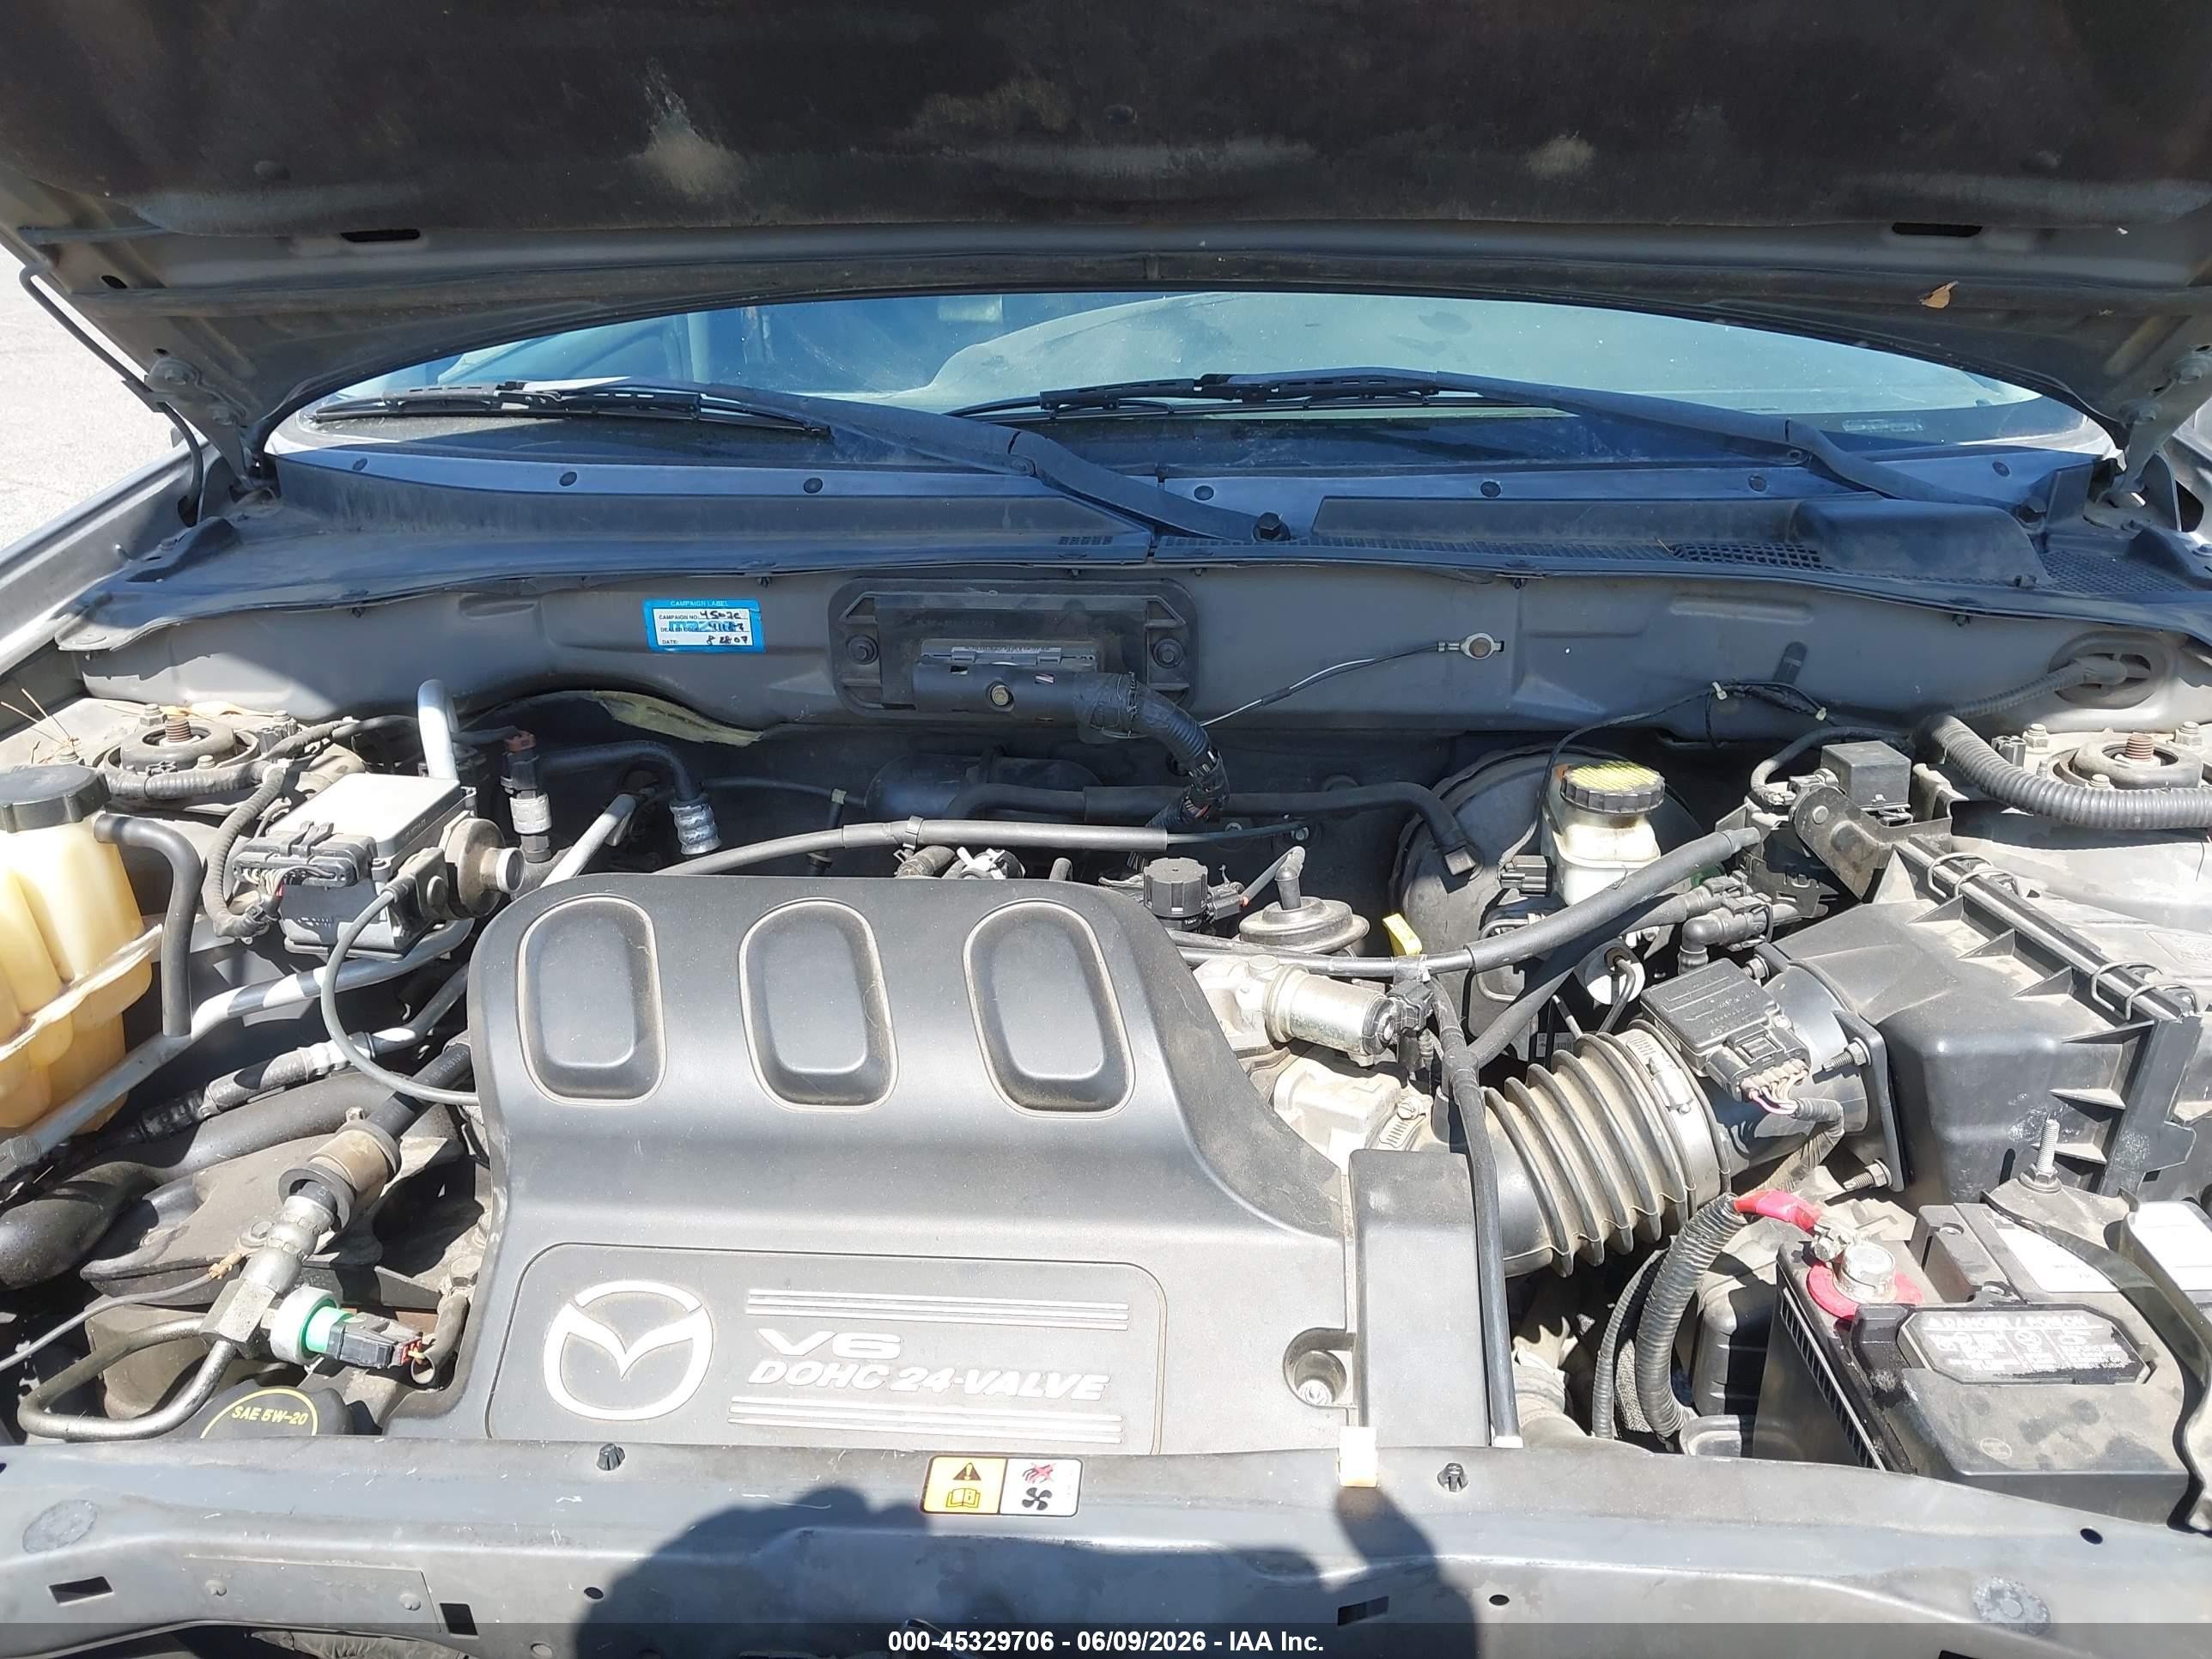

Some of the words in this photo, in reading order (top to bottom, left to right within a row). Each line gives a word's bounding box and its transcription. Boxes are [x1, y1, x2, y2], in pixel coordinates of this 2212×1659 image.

[757, 1328, 902, 1359] V6
[747, 1360, 890, 1389] DOHC
[890, 1366, 1112, 1401] 24-VALVE
[232, 1405, 262, 1421] SAE
[261, 1408, 309, 1426] 5W-20
